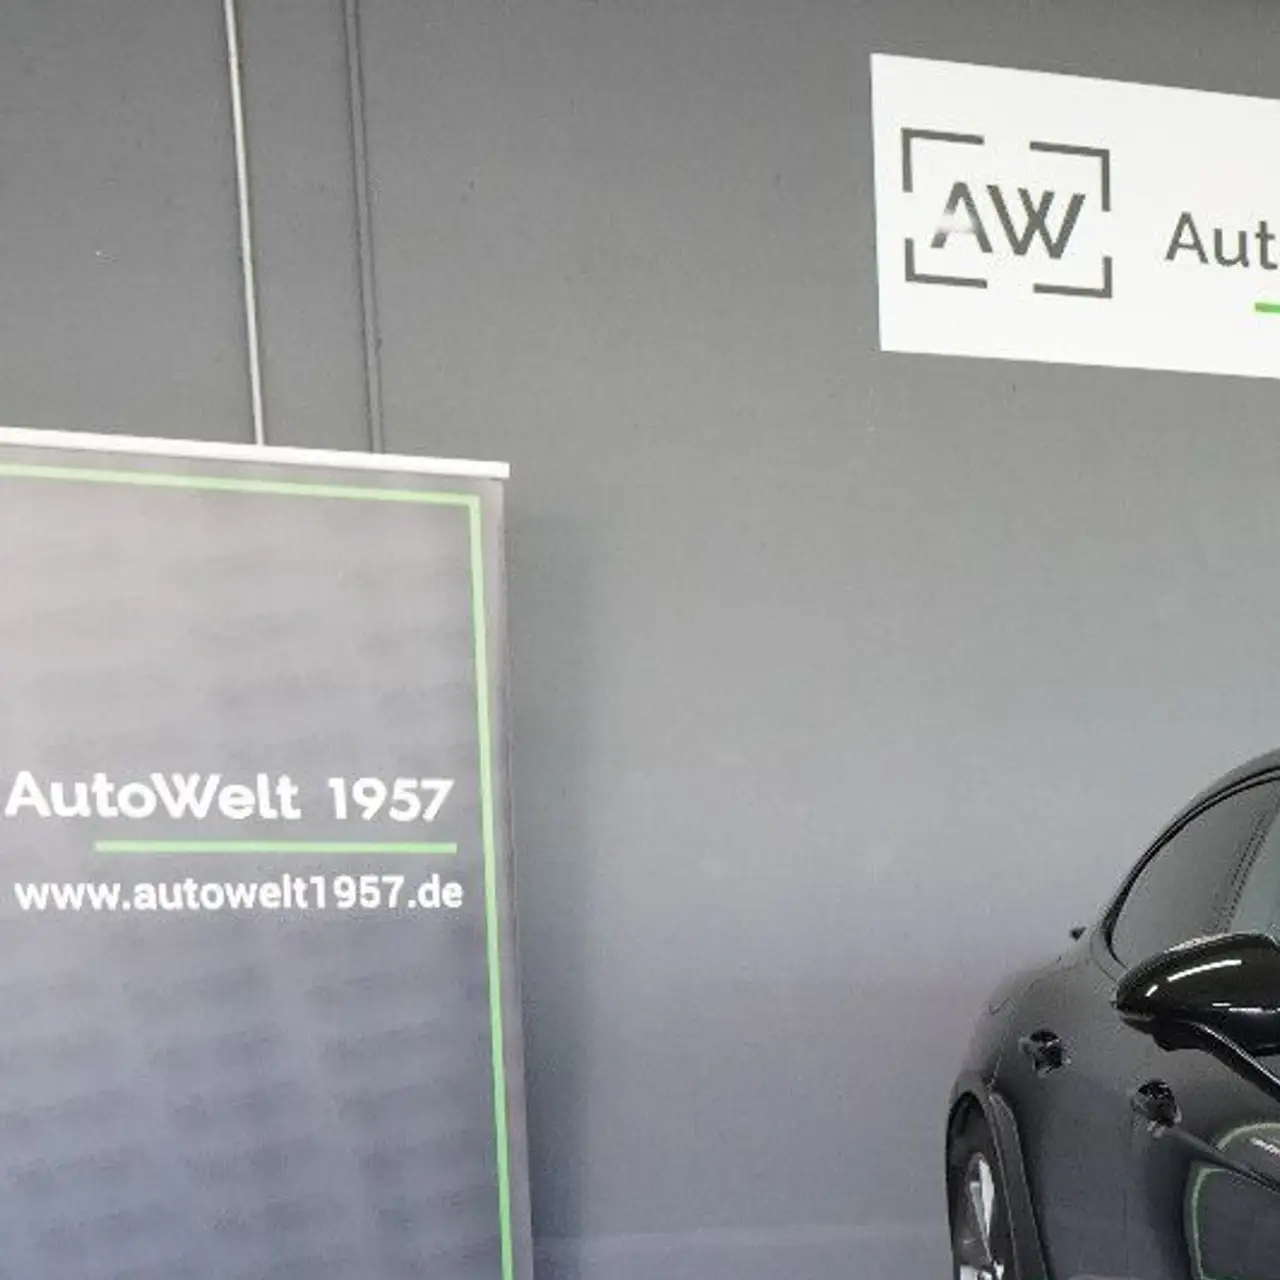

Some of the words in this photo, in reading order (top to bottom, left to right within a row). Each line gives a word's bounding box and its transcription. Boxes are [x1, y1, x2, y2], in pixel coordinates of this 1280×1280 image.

[929, 180, 1087, 261] AW
[3, 770, 302, 821] AutoWelt
[328, 777, 455, 823] 1957
[14, 873, 464, 911] www.autowelt1957.de
